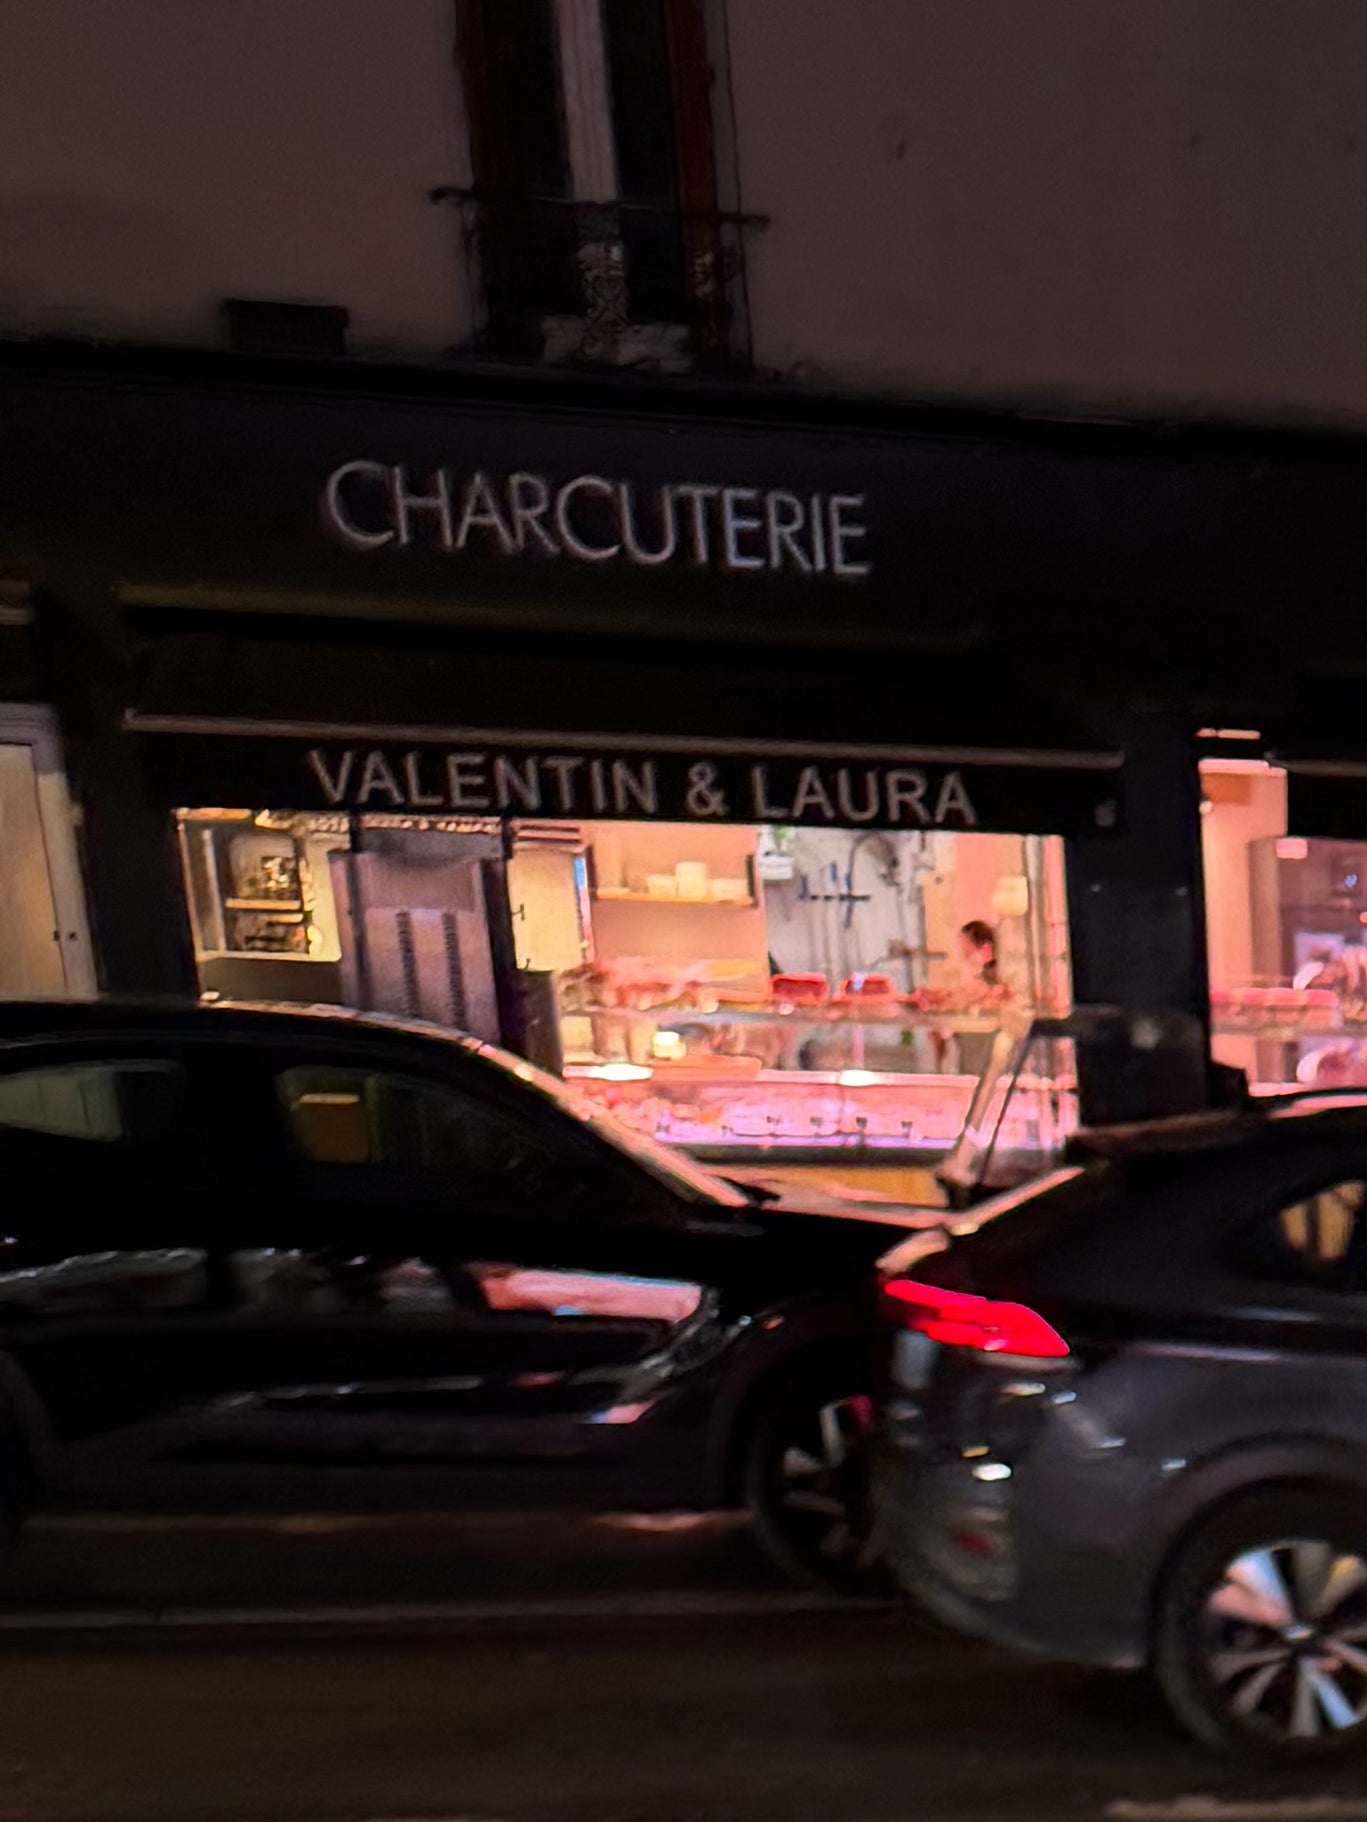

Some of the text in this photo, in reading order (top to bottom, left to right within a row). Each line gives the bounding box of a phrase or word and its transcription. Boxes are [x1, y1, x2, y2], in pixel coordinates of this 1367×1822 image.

[326, 459, 871, 577] CHARCUTERIE
[308, 748, 978, 826] VALENTIN & LAURA
